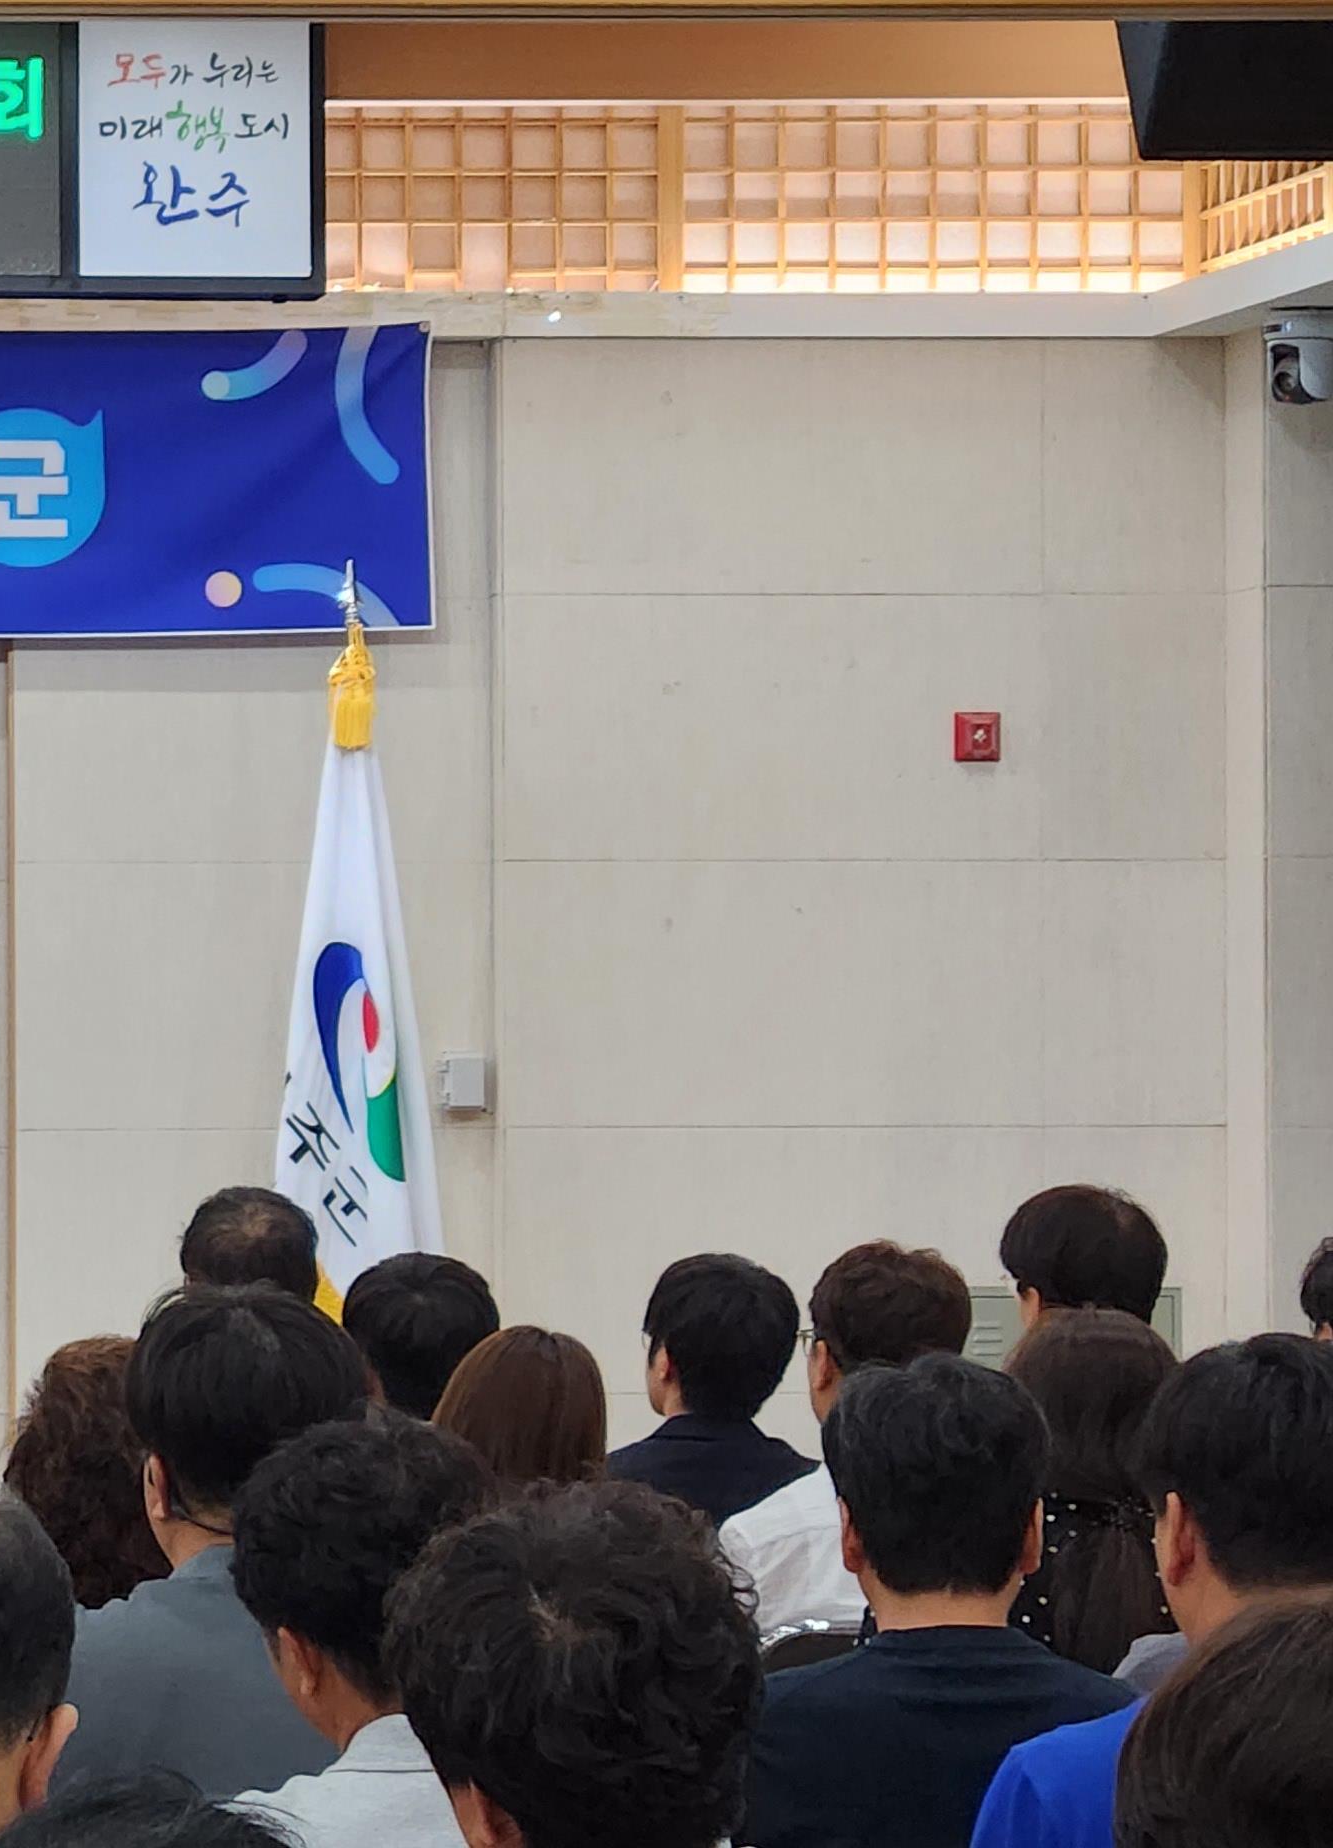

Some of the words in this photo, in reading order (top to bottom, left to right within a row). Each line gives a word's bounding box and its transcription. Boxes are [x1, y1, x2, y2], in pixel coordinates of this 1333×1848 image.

[107, 52, 194, 89] 모두가
[202, 52, 280, 89] 누리는
[99, 114, 163, 141] 미래
[165, 100, 230, 154] 행복
[234, 112, 290, 141] 도시
[132, 160, 251, 228] 완주
